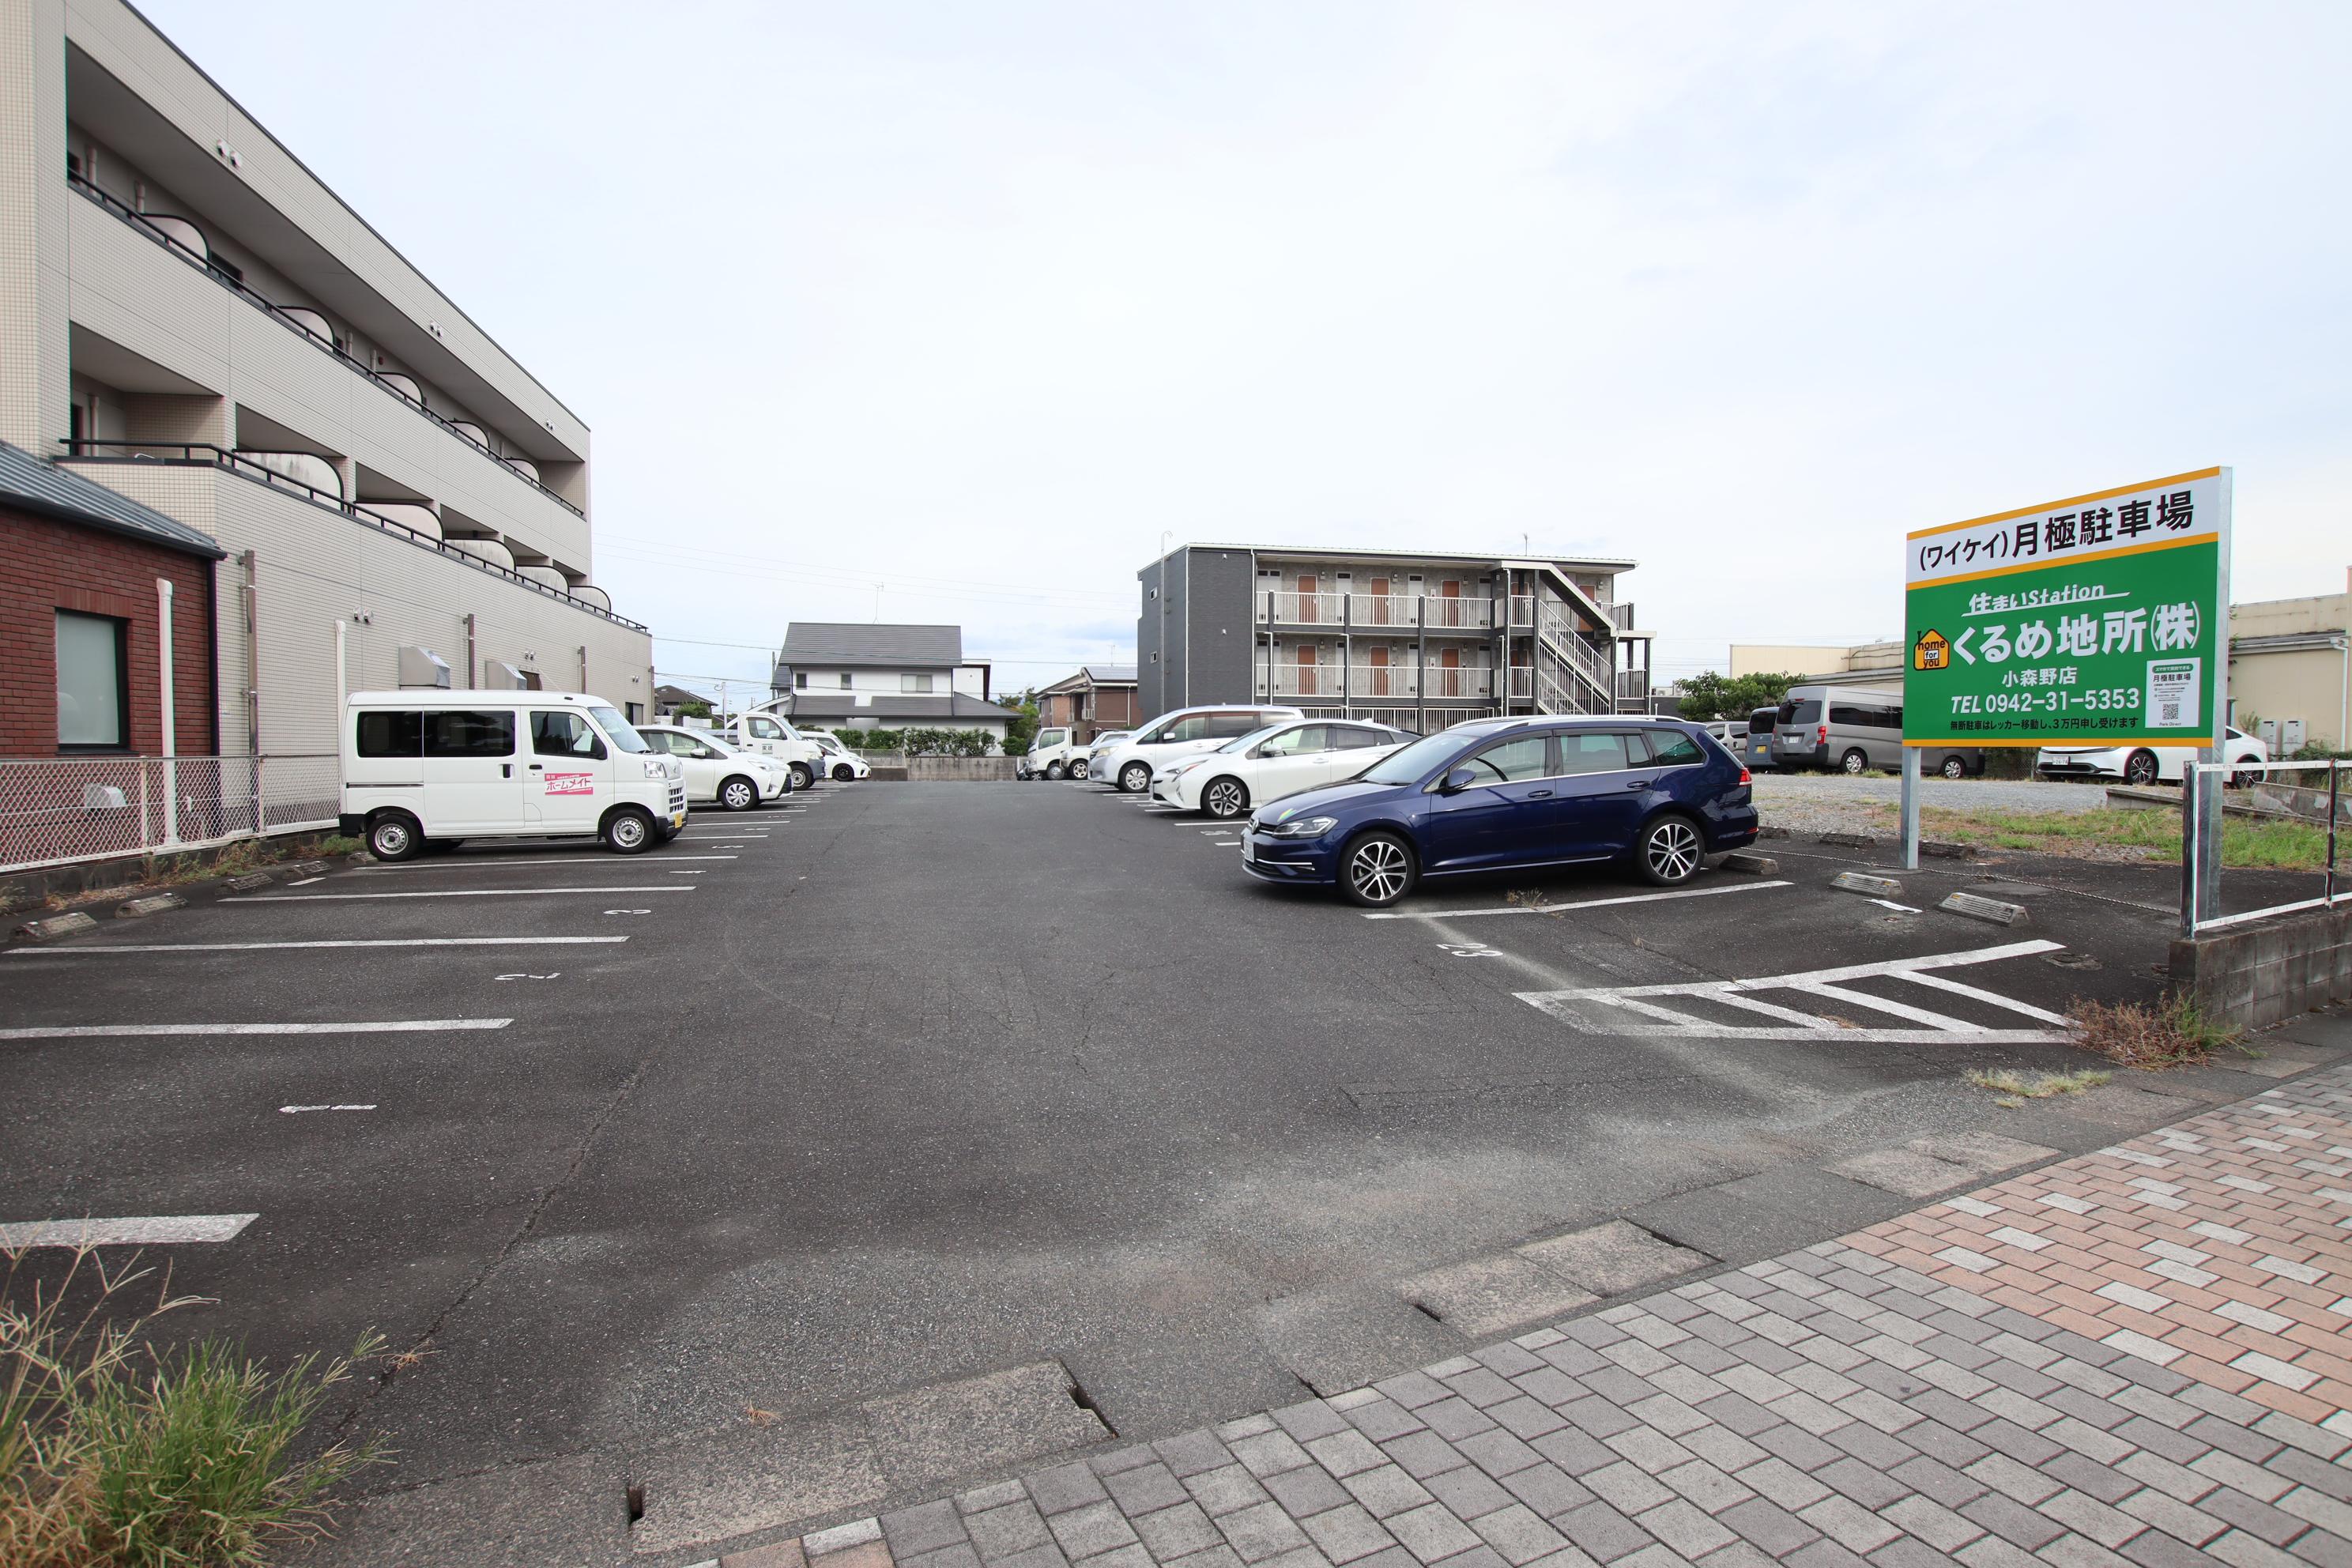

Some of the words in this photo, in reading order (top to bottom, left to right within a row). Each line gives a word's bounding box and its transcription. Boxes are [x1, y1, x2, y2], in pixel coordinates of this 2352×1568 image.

[1953, 601, 2199, 665] くるめ地所(株)
[1917, 640, 1946, 650] home
[1924, 659, 1939, 669] you
[2002, 666, 2078, 688] 小森野店
[1951, 695, 1981, 714] TEL
[1985, 688, 2139, 713] 0942-31-5353
[546, 777, 591, 791] ホームメイト
[1435, 943, 1503, 957] 23
